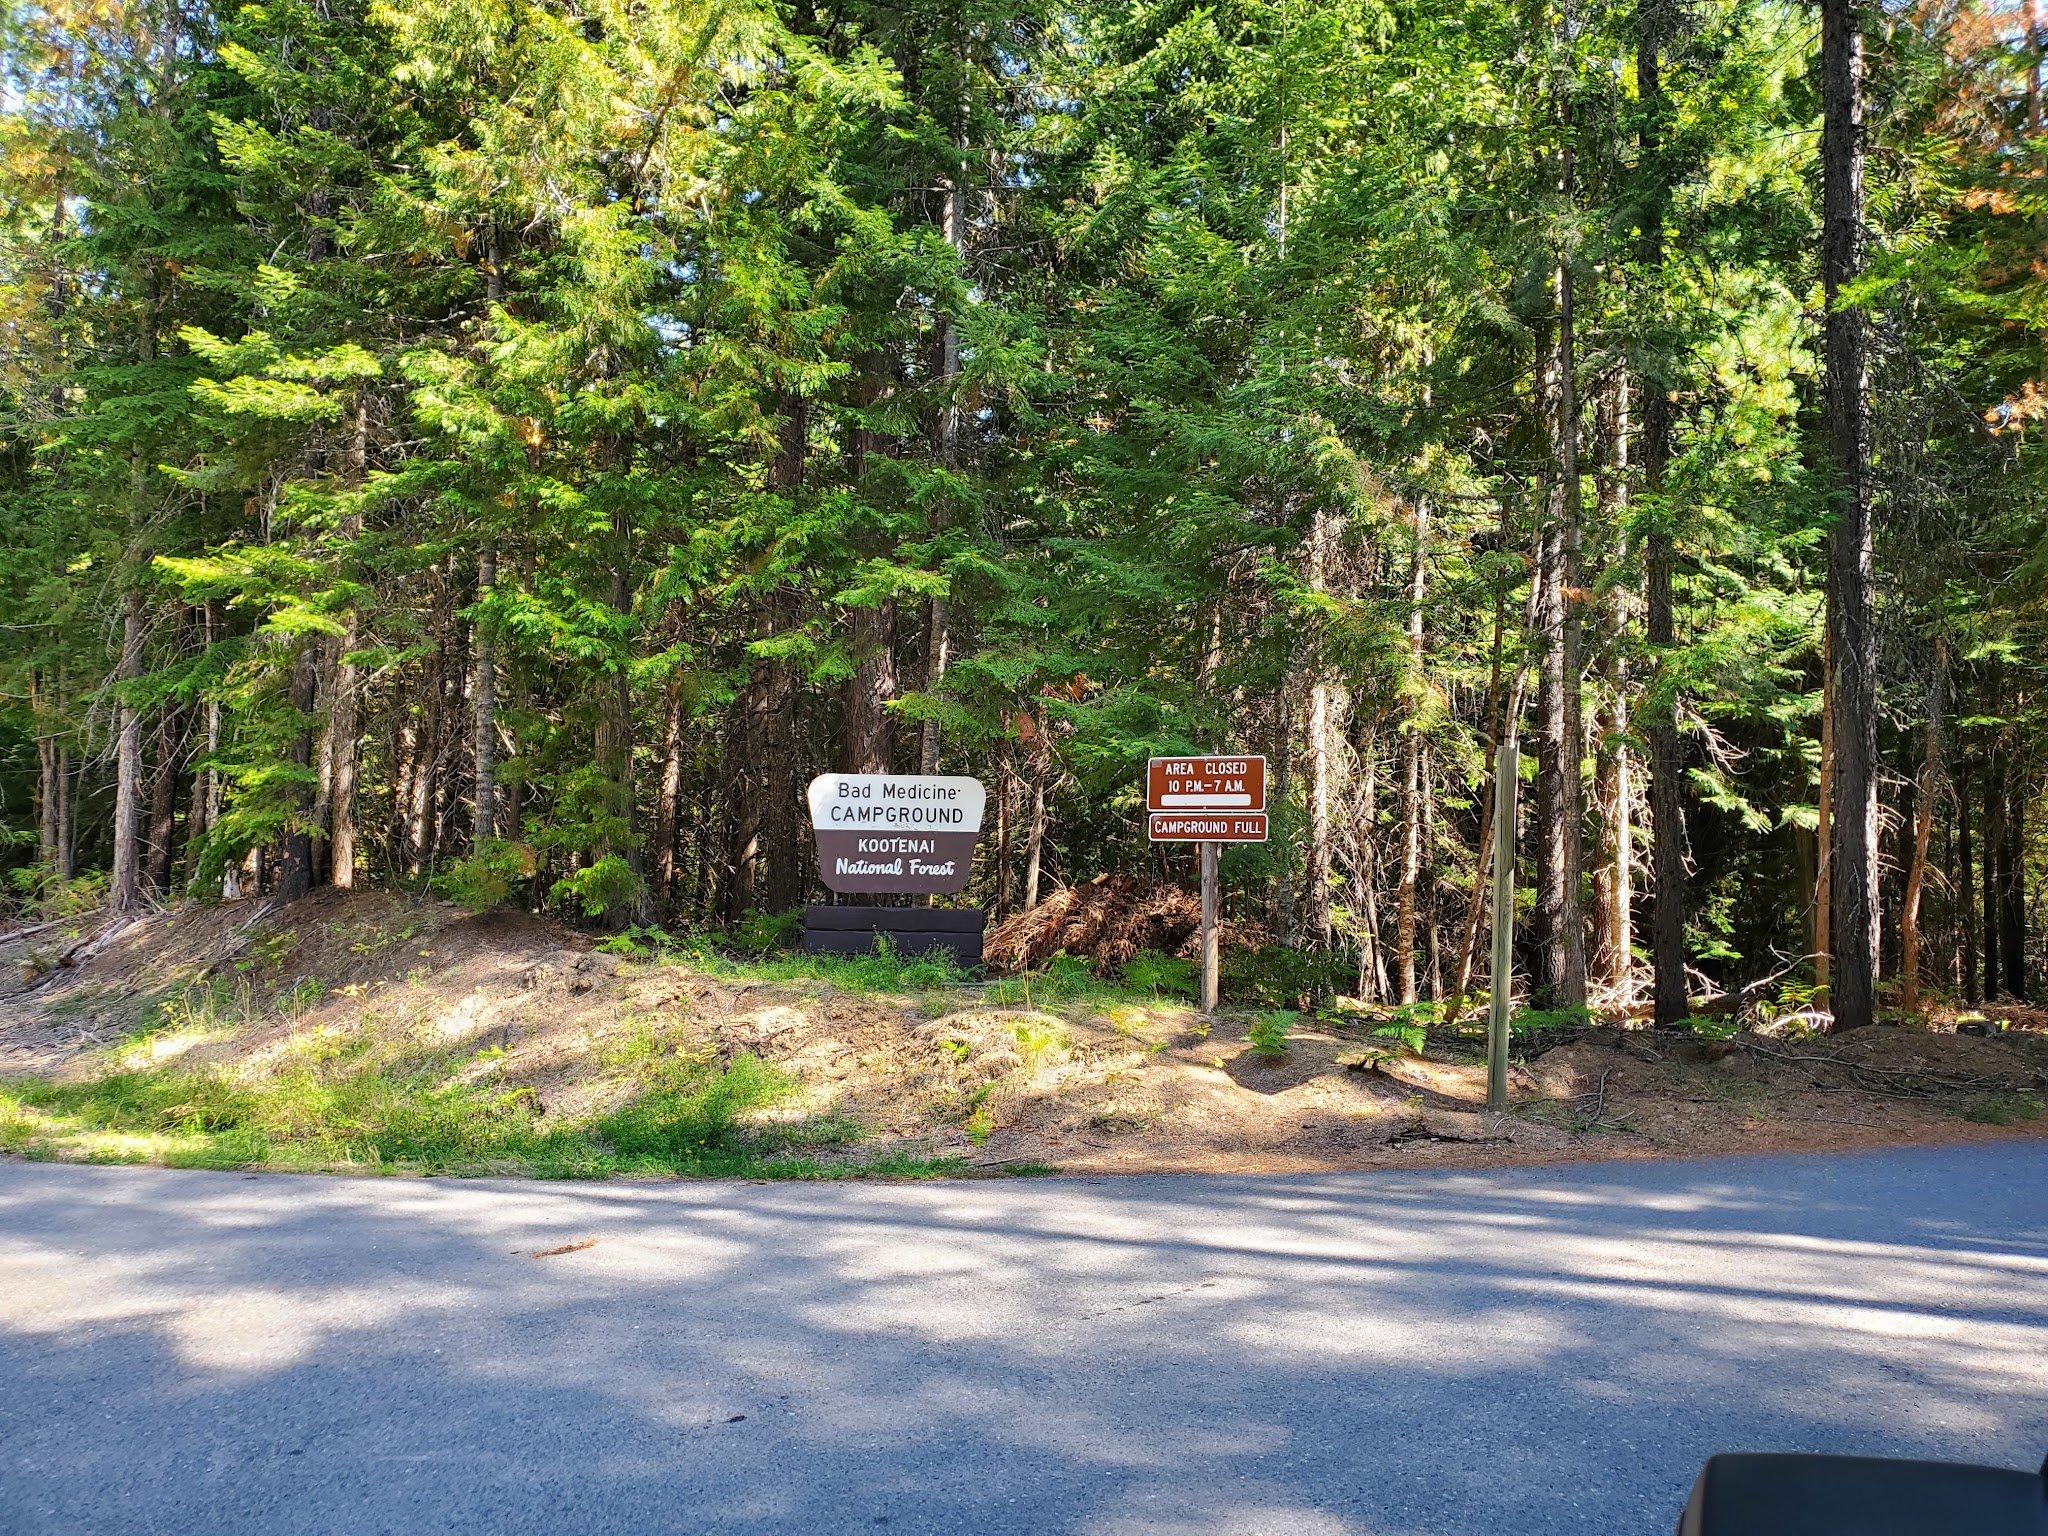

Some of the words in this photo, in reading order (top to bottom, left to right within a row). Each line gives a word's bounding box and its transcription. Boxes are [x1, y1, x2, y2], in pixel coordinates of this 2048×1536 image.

[1165, 763, 1194, 775] AREA
[1205, 762, 1247, 775] CLOSED
[838, 782, 871, 798] Bad
[883, 783, 957, 800] Medicine
[1168, 780, 1180, 793] 10
[1224, 779, 1246, 792] A.M.
[831, 806, 964, 824] CAMPGROUND
[1154, 821, 1228, 834] CAMPGROUND
[1234, 821, 1262, 834] FULL
[858, 838, 935, 854] KOOTENAI
[835, 857, 903, 876] National
[908, 858, 956, 876] Forest
